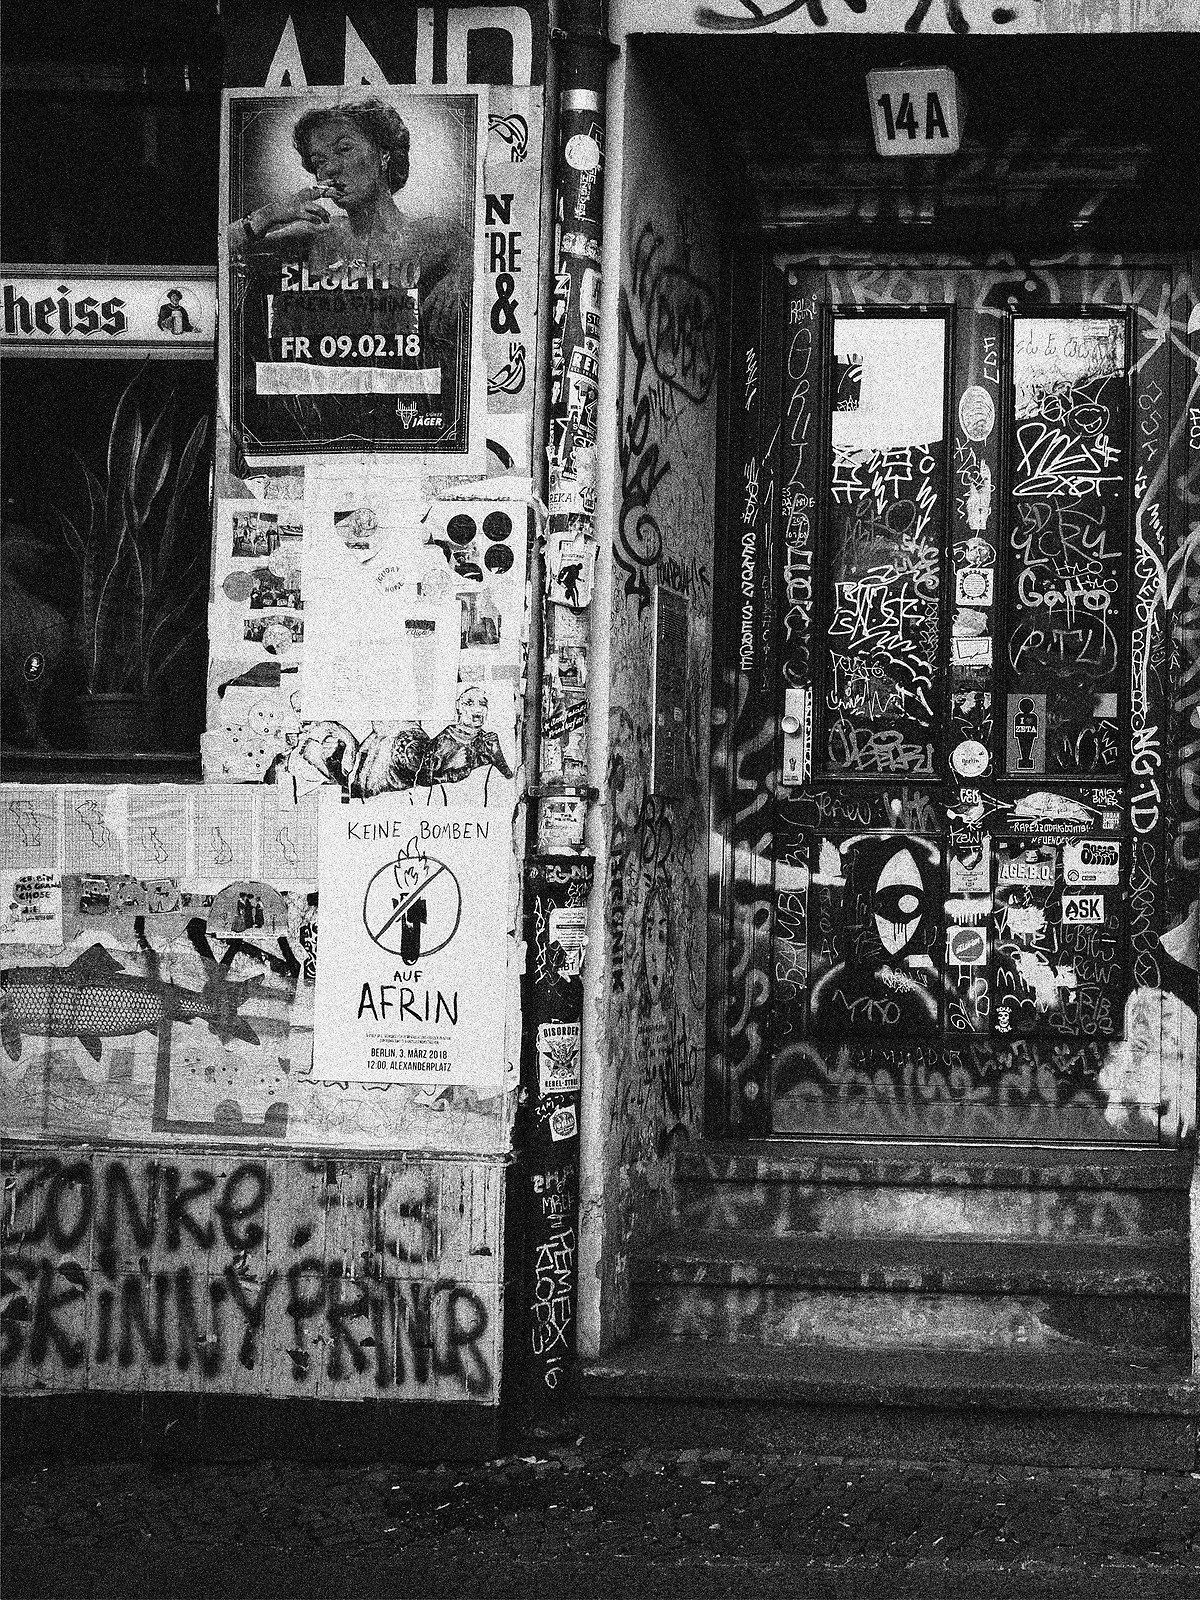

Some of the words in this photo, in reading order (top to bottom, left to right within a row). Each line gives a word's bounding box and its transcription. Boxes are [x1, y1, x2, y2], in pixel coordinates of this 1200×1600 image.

[877, 91, 950, 141] 14A
[281, 336, 312, 359] FR
[319, 334, 421, 359] 09.02.18
[412, 415, 443, 428] JÄGER
[1014, 725, 1038, 733] ZETA
[348, 820, 402, 840] KEINE
[419, 820, 490, 840] BOMBEN
[1064, 898, 1100, 919] ASK
[392, 970, 423, 983] AUF
[357, 982, 459, 1026] AFRIN
[543, 1026, 579, 1038] DISORDER
[407, 1047, 428, 1059] MÄRZ
[428, 1050, 448, 1060] 2018
[389, 1061, 452, 1072] ALEXANDERPLATZ
